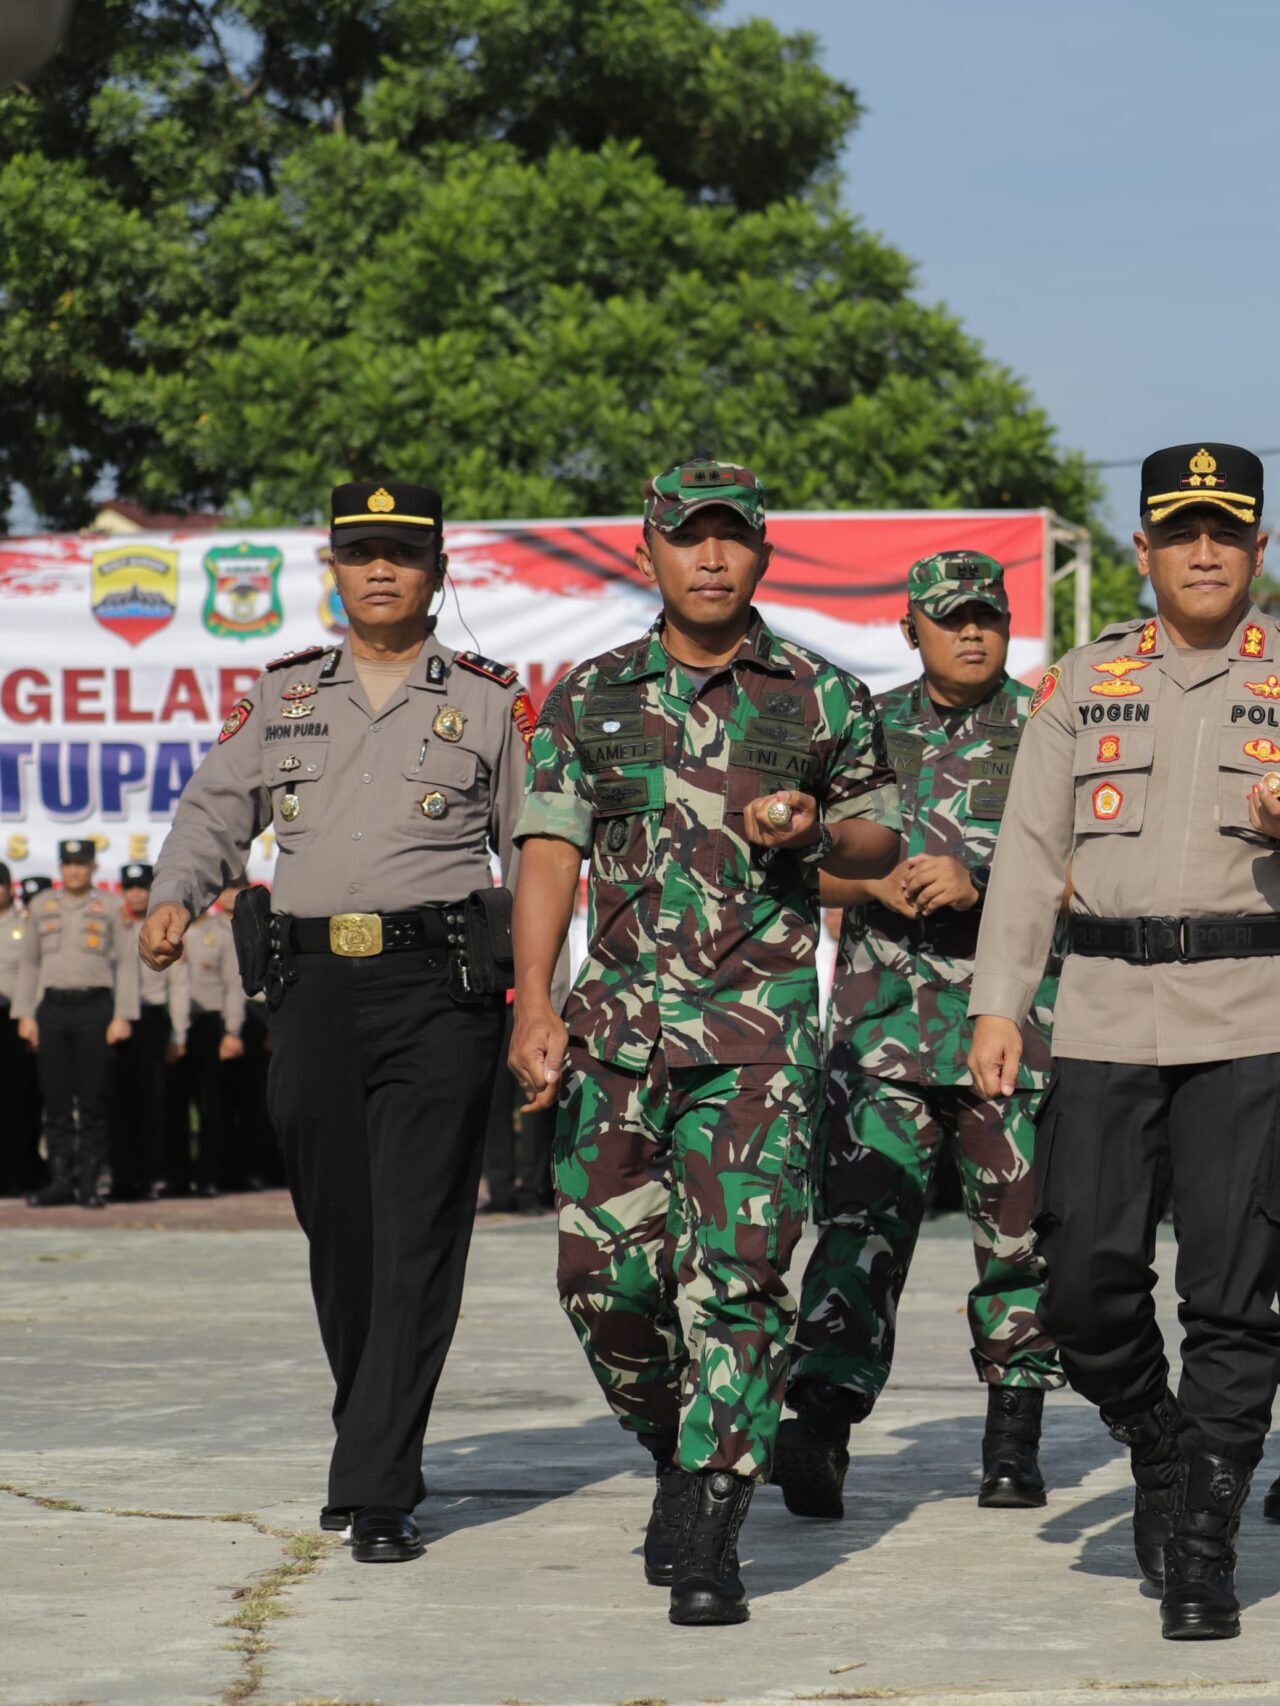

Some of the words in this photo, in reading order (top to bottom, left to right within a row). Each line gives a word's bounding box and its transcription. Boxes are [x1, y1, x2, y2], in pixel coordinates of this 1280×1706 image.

[1079, 703, 1150, 725] YOGEN
[293, 722, 329, 738] PURBA
[743, 747, 777, 766] TNI
[786, 755, 811, 774] AD
[979, 761, 1009, 775] TNI
